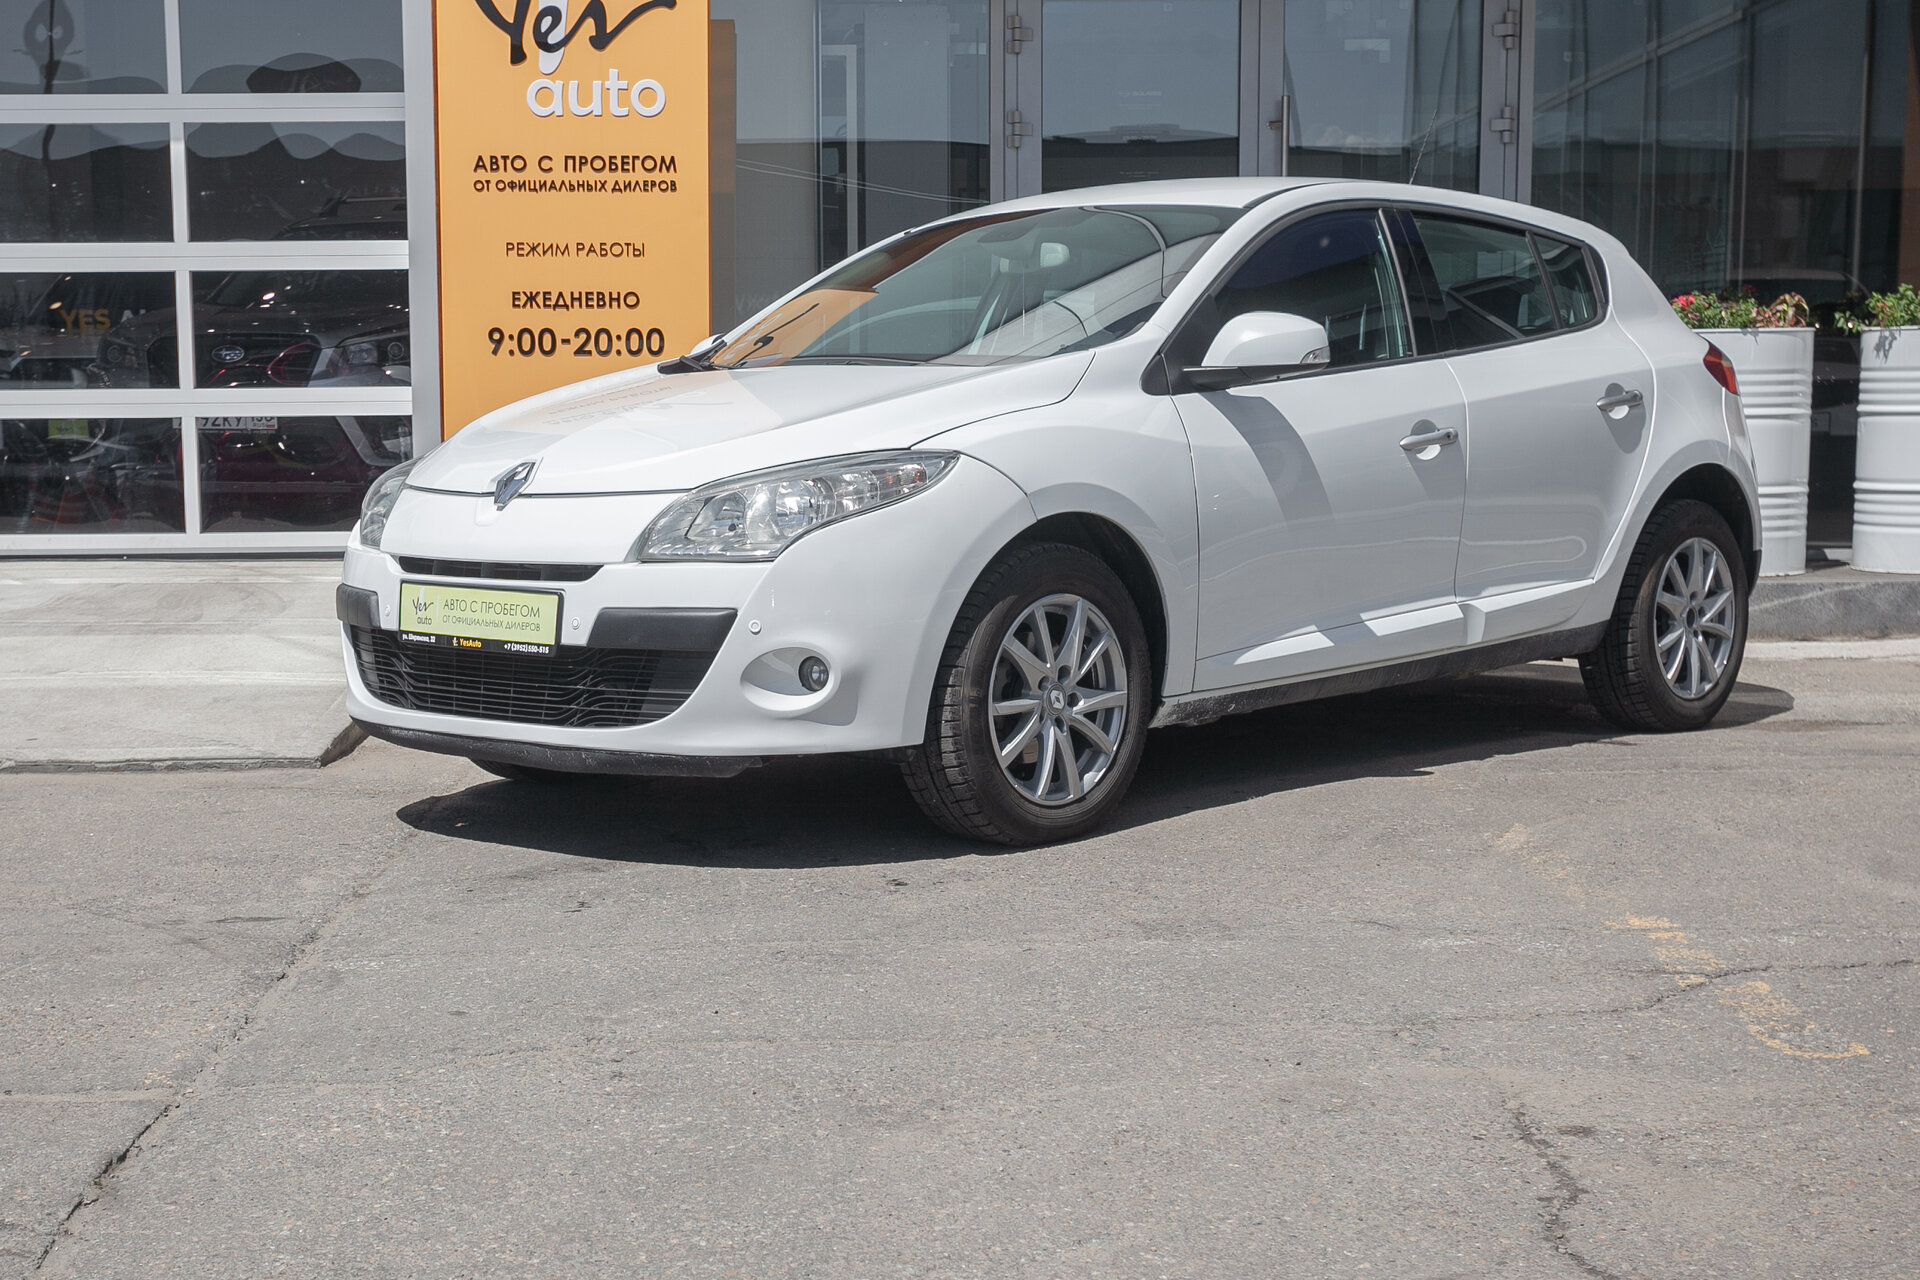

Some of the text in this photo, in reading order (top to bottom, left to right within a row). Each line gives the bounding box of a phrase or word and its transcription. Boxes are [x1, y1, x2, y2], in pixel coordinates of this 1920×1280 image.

[526, 68, 667, 118] auto
[473, 154, 678, 174] АВТО С ПРОБЕГОМ
[473, 179, 678, 194] ОТ ОФИЦИАЛЬНЫХ ДИЛЕРОВ
[505, 242, 646, 258] РЕЖИМ РАБОТЫ
[511, 291, 641, 312] ЕЖЕДНЕВНО
[60, 308, 111, 331] YES
[487, 327, 666, 358] 9:00-20:00
[443, 599, 541, 618] АВТО С ПРОБЕГОМ
[416, 616, 433, 626] auto
[442, 614, 541, 632] ОТ ОФИЦИАЛЬНЫХ ДИЛЕРОВ
[459, 638, 482, 648] YesAuto
